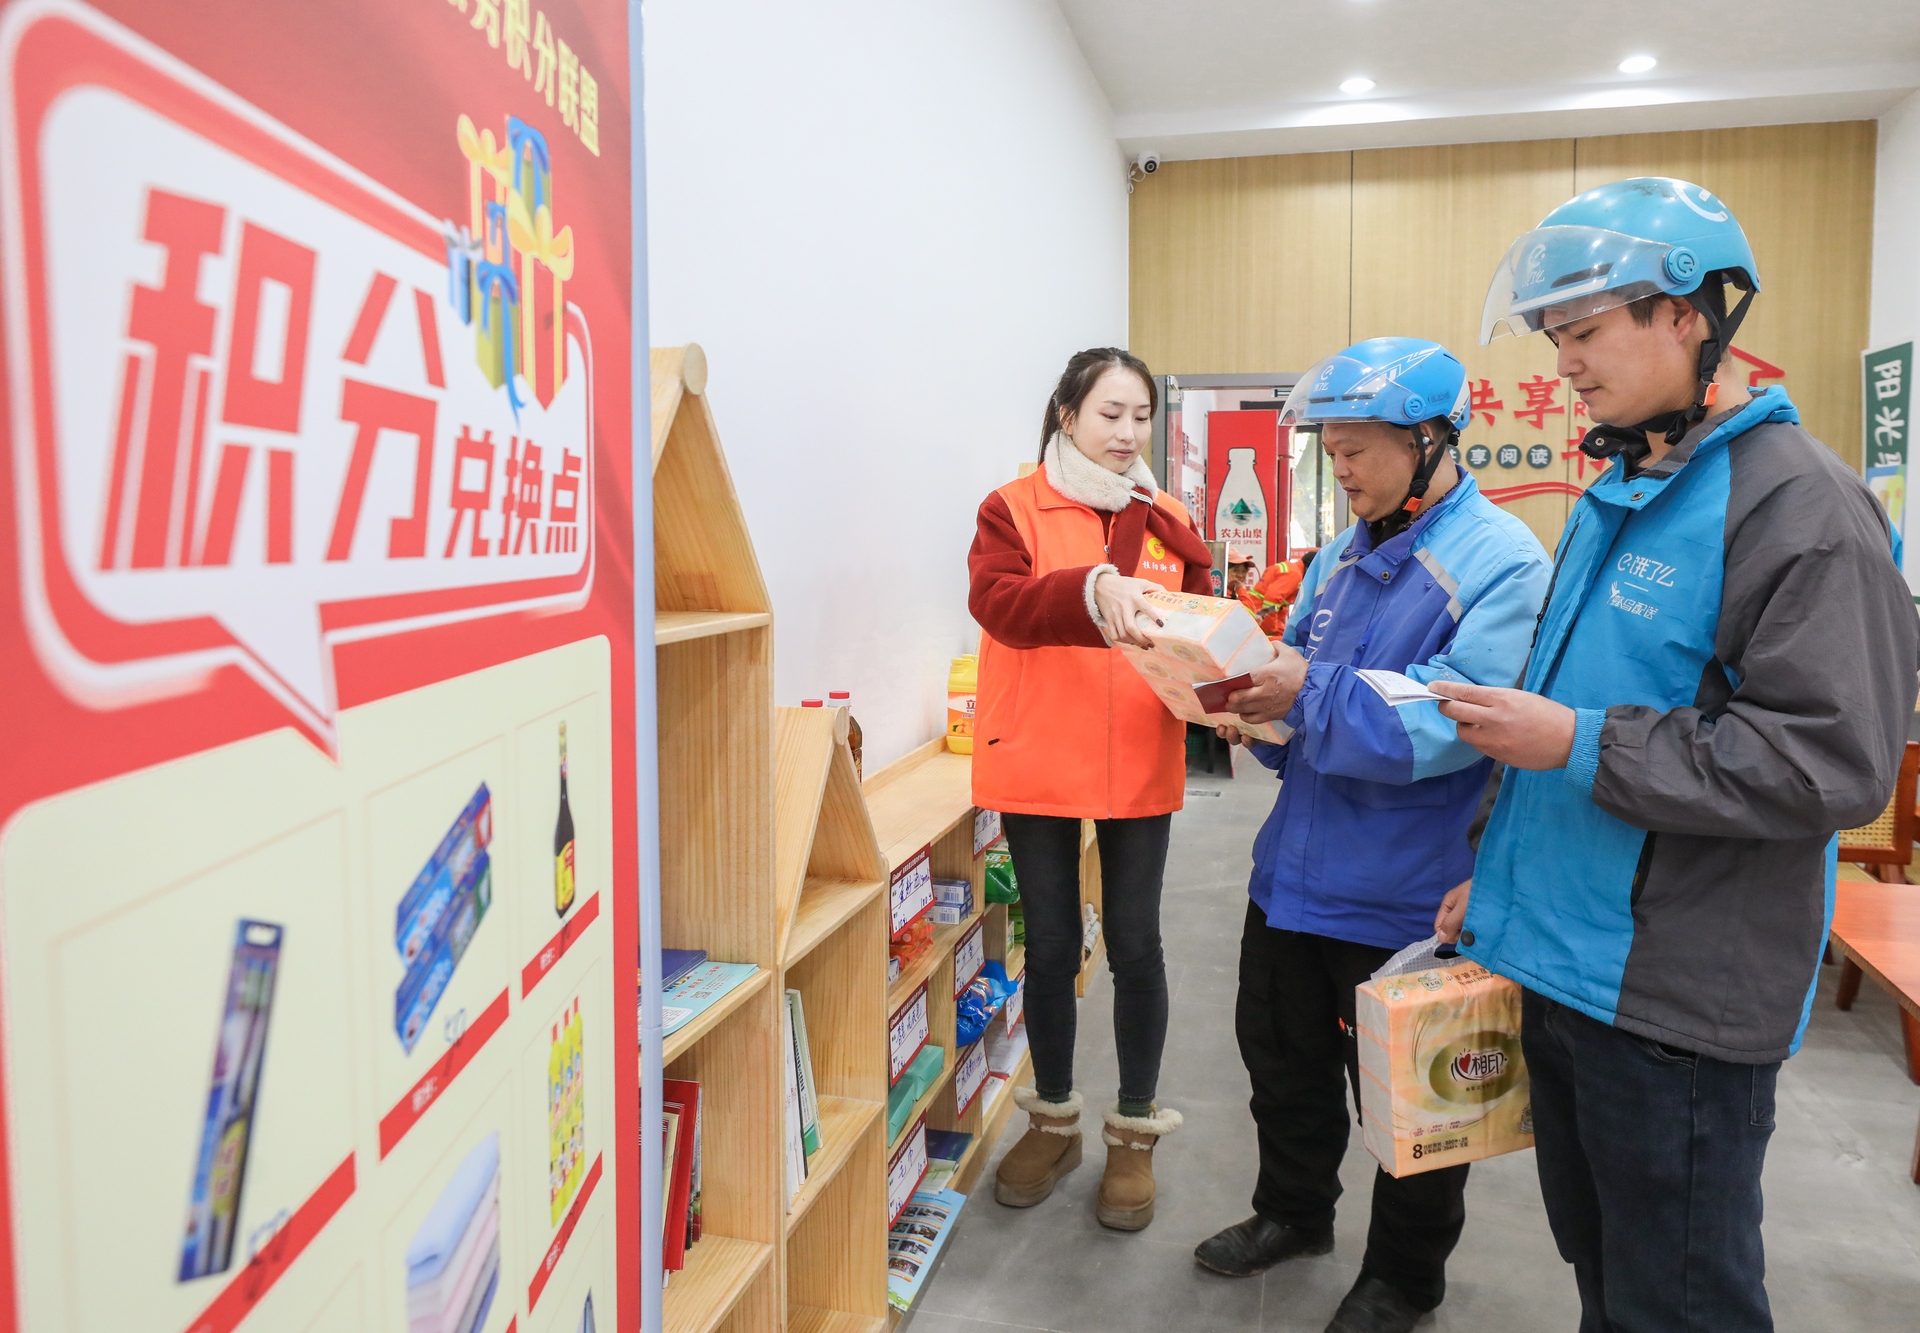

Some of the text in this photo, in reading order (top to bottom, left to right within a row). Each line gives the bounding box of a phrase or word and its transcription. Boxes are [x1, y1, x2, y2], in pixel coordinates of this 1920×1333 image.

[1469, 374, 1565, 430] 共享
[1574, 401, 1590, 418] R
[1220, 528, 1263, 539] 农夫山泉
[1629, 555, 1677, 588] 饿了么
[1610, 594, 1659, 620] 蜂鸟配送
[1413, 1143, 1423, 1159] 8
